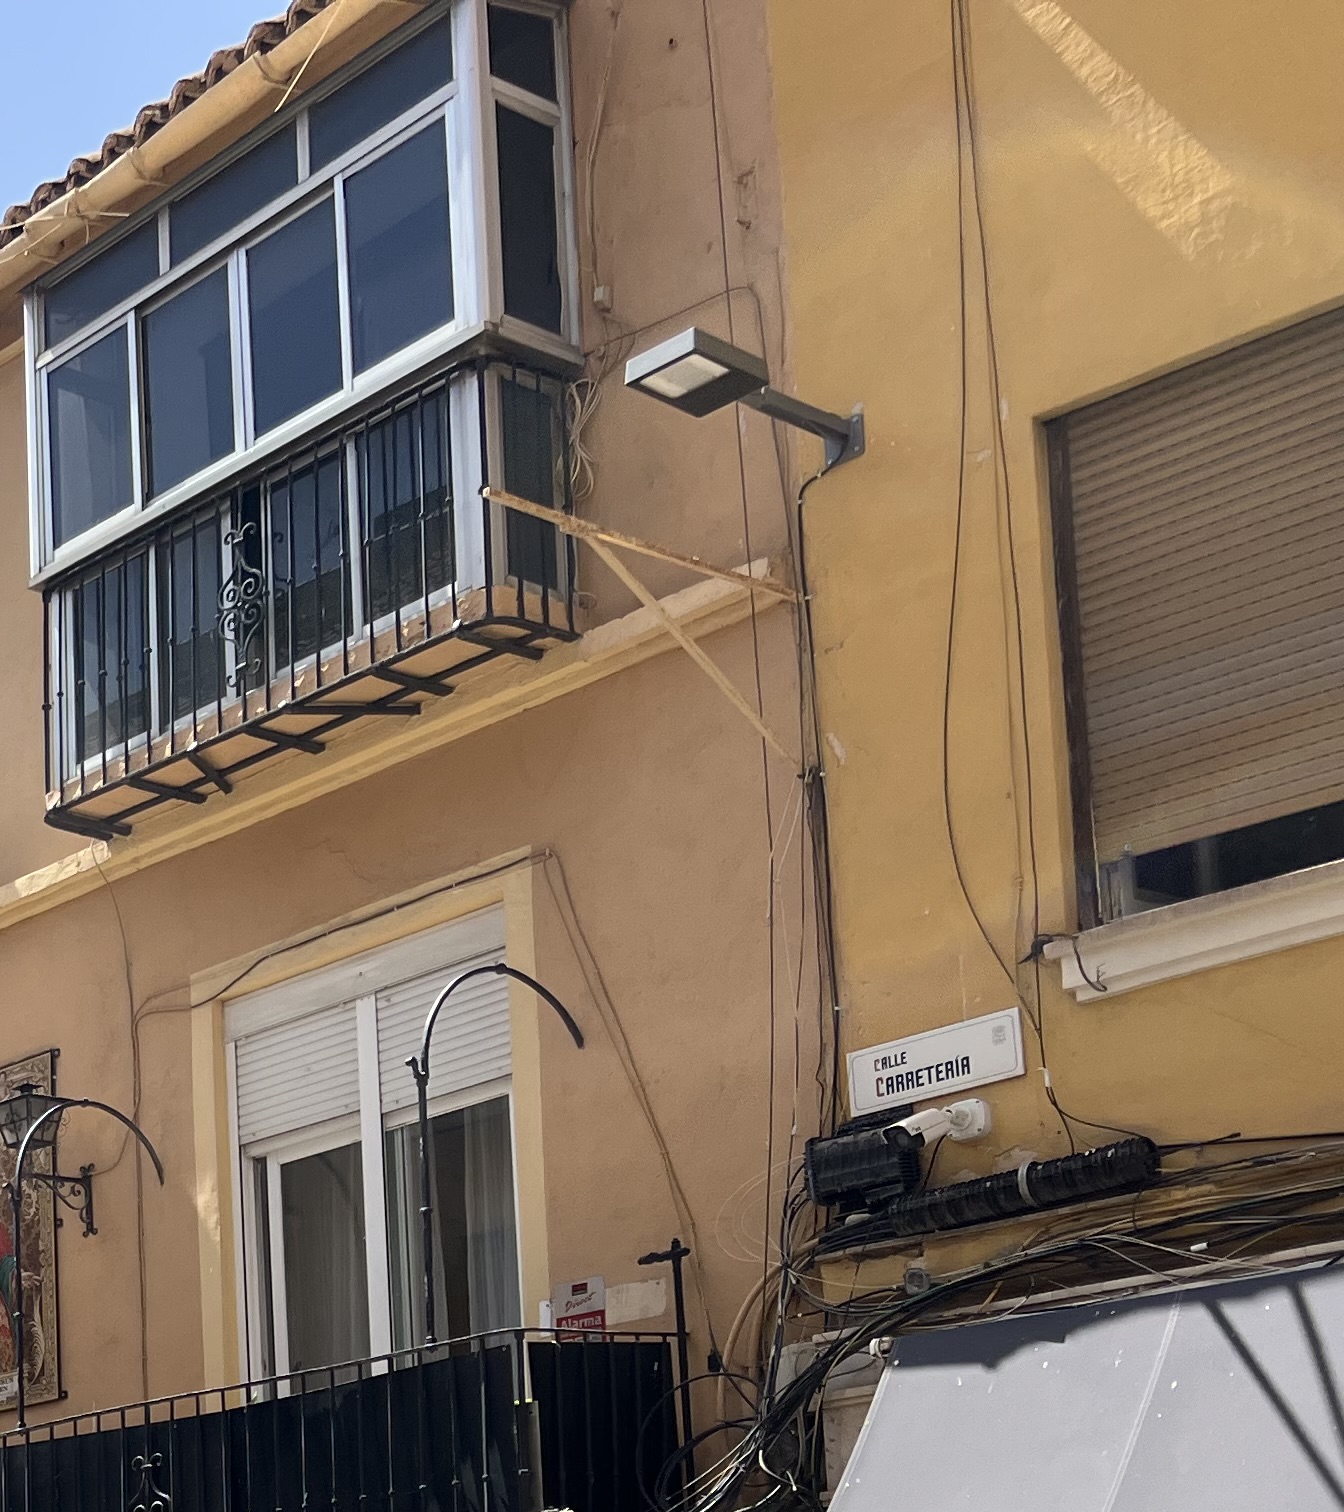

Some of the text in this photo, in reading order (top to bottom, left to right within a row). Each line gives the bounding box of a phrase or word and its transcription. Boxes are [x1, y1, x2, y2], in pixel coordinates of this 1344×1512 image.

[874, 1052, 907, 1072] CALLE
[876, 1055, 971, 1097] CARRETERÍA
[562, 1316, 602, 1328] Alarma
